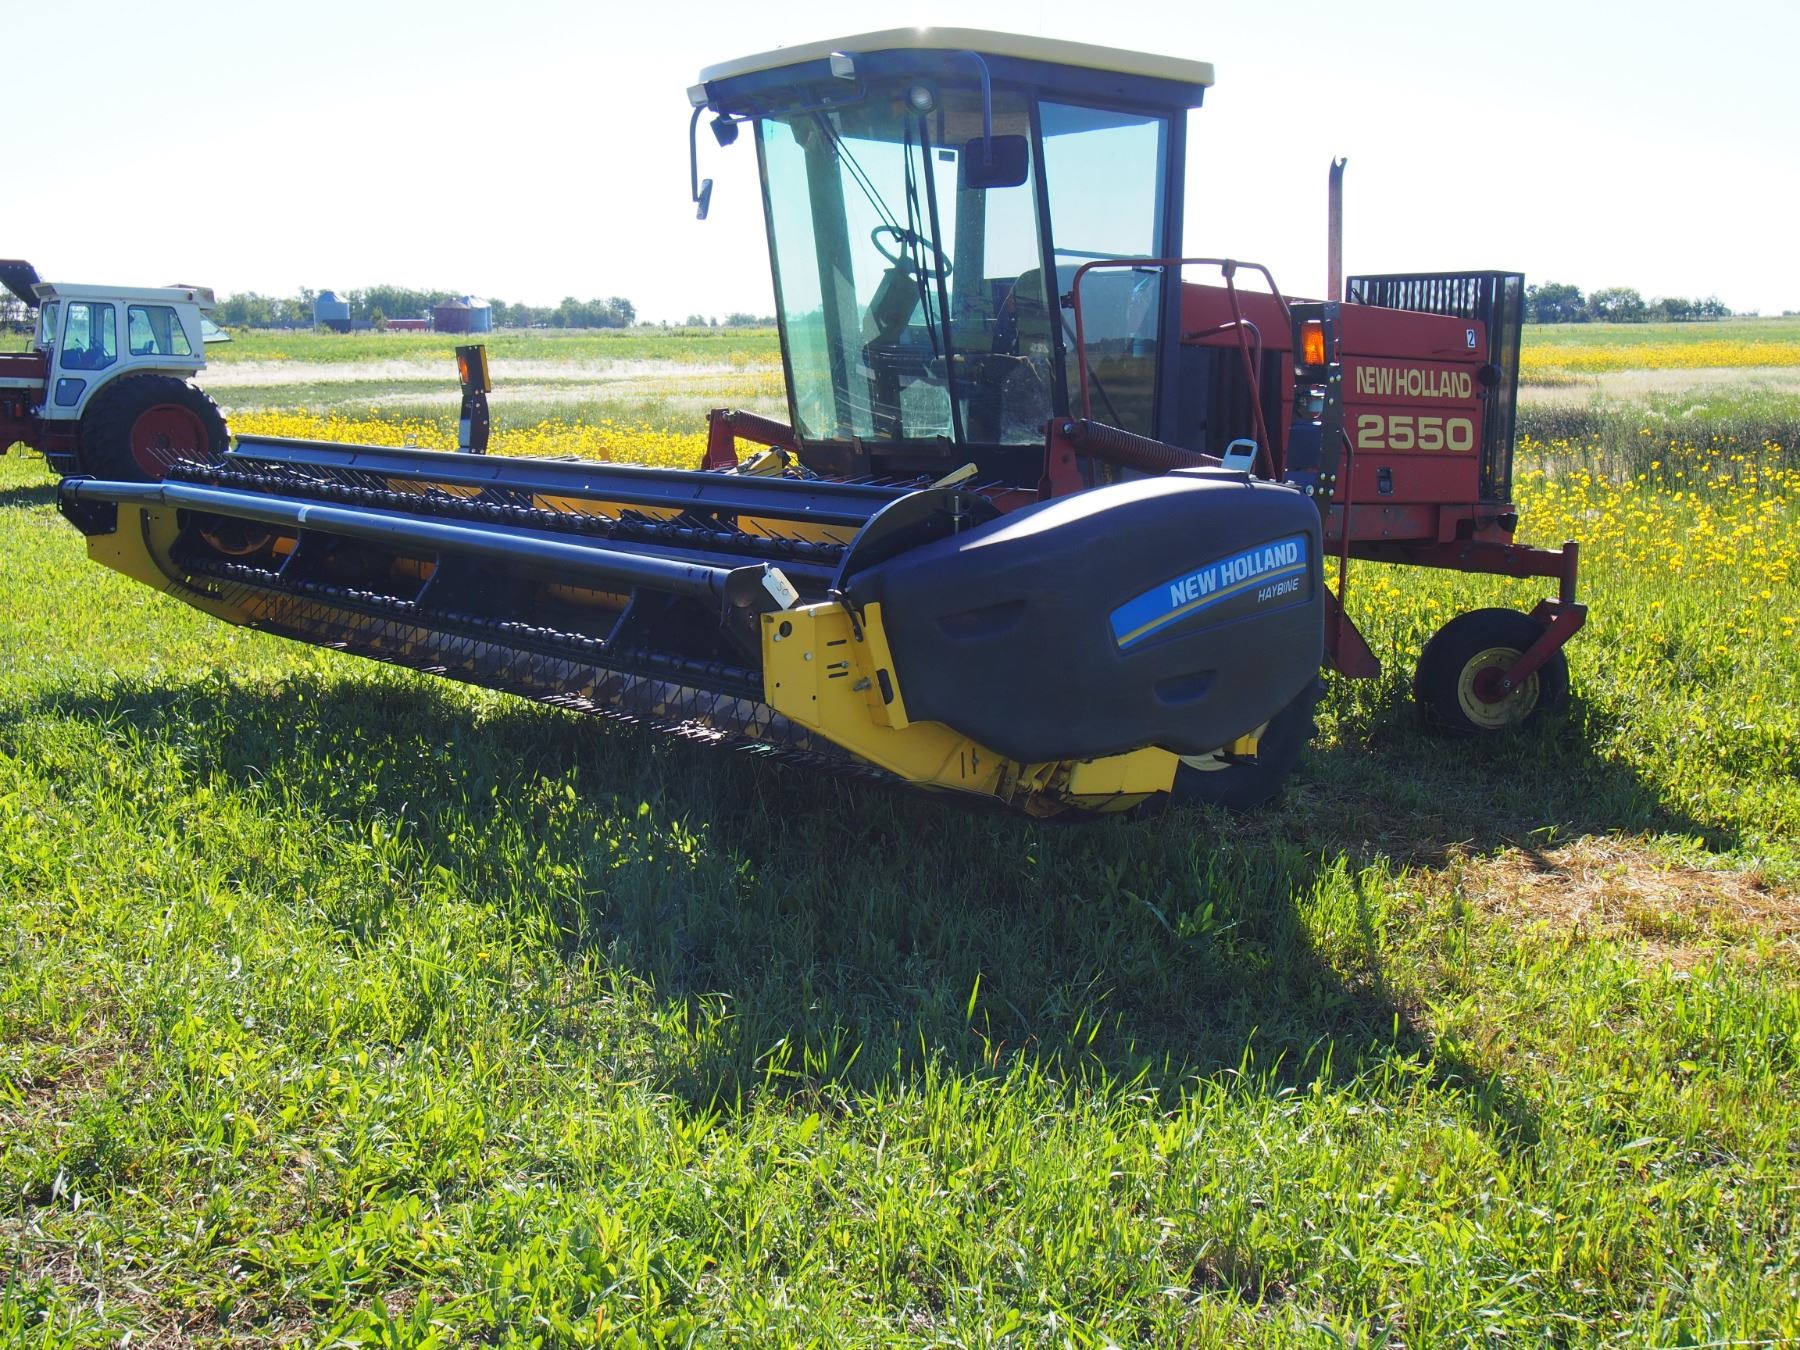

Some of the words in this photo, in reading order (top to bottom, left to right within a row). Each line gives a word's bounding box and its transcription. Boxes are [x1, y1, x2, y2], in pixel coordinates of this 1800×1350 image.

[1467, 330, 1475, 347] 2
[1356, 366, 1394, 395] NEW
[1395, 368, 1472, 399] HOLLAND
[1357, 414, 1474, 451] 2550
[1169, 567, 1217, 608] NEW
[1220, 542, 1298, 587] HOLLAND
[1257, 577, 1300, 603] HAYBINE
